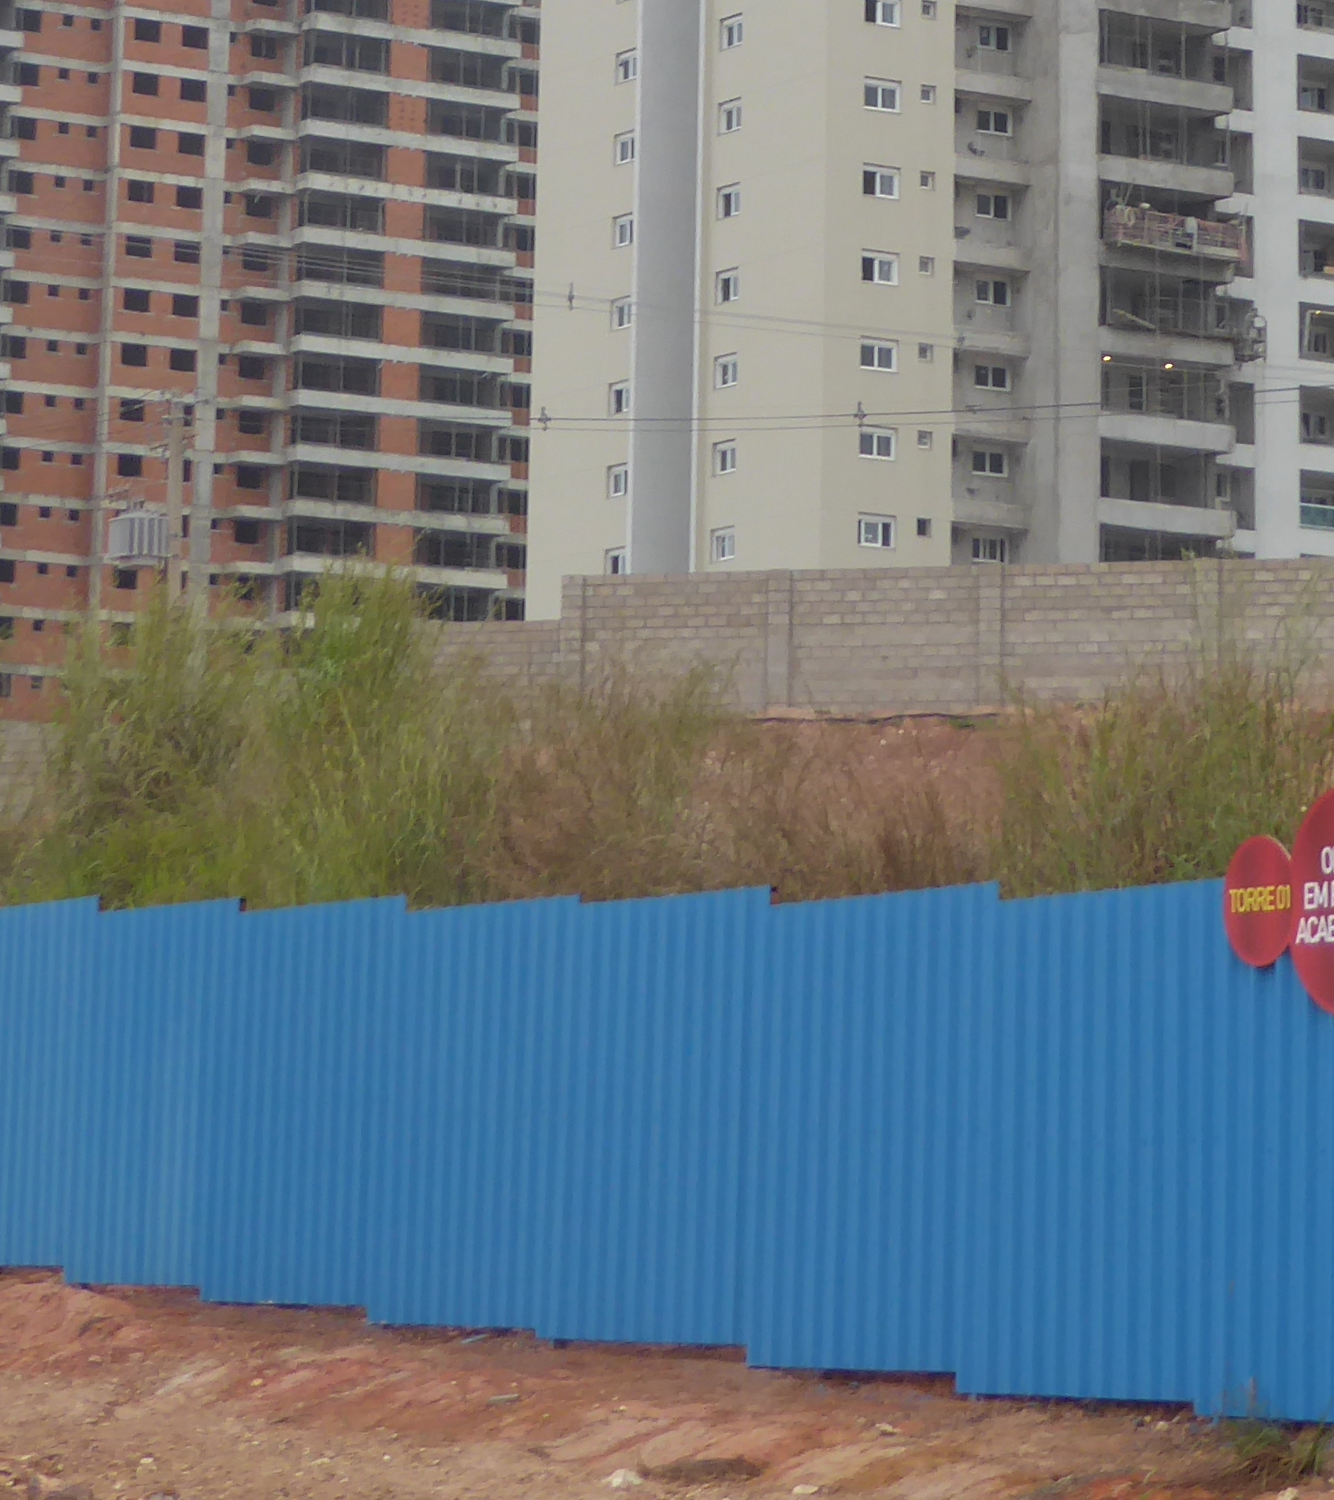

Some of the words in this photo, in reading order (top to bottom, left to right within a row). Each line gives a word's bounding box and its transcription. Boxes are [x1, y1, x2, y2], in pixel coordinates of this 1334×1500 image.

[1229, 885, 1275, 913] TORRE
[1276, 885, 1291, 909] 01
[1303, 881, 1328, 910] EM
